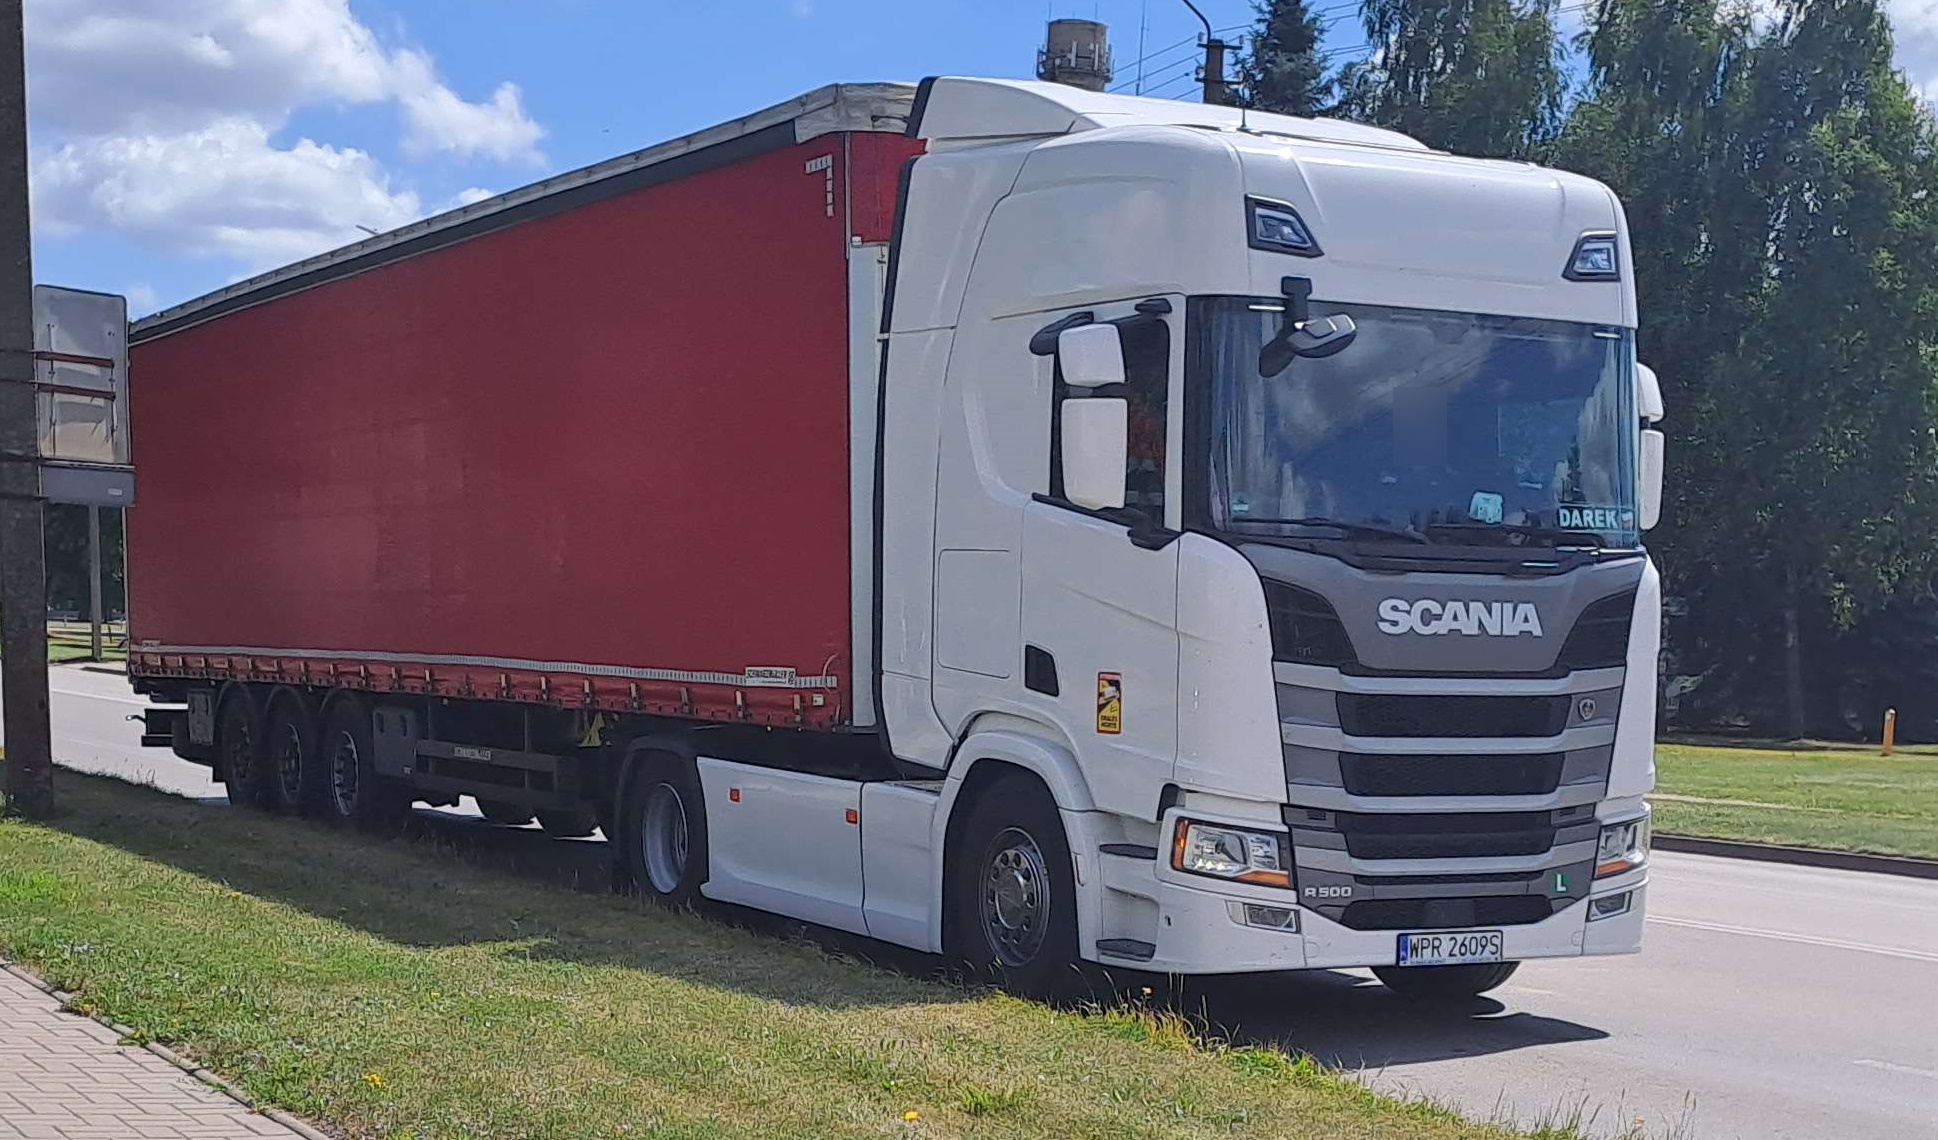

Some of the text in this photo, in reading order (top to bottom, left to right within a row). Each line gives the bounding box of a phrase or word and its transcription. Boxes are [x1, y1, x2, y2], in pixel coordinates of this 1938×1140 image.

[1559, 508, 1619, 529] DAREK
[1376, 598, 1543, 637] SCANIA
[1556, 873, 1567, 892] L
[1409, 937, 1443, 959] WPR
[1448, 935, 1500, 957] 2609S
